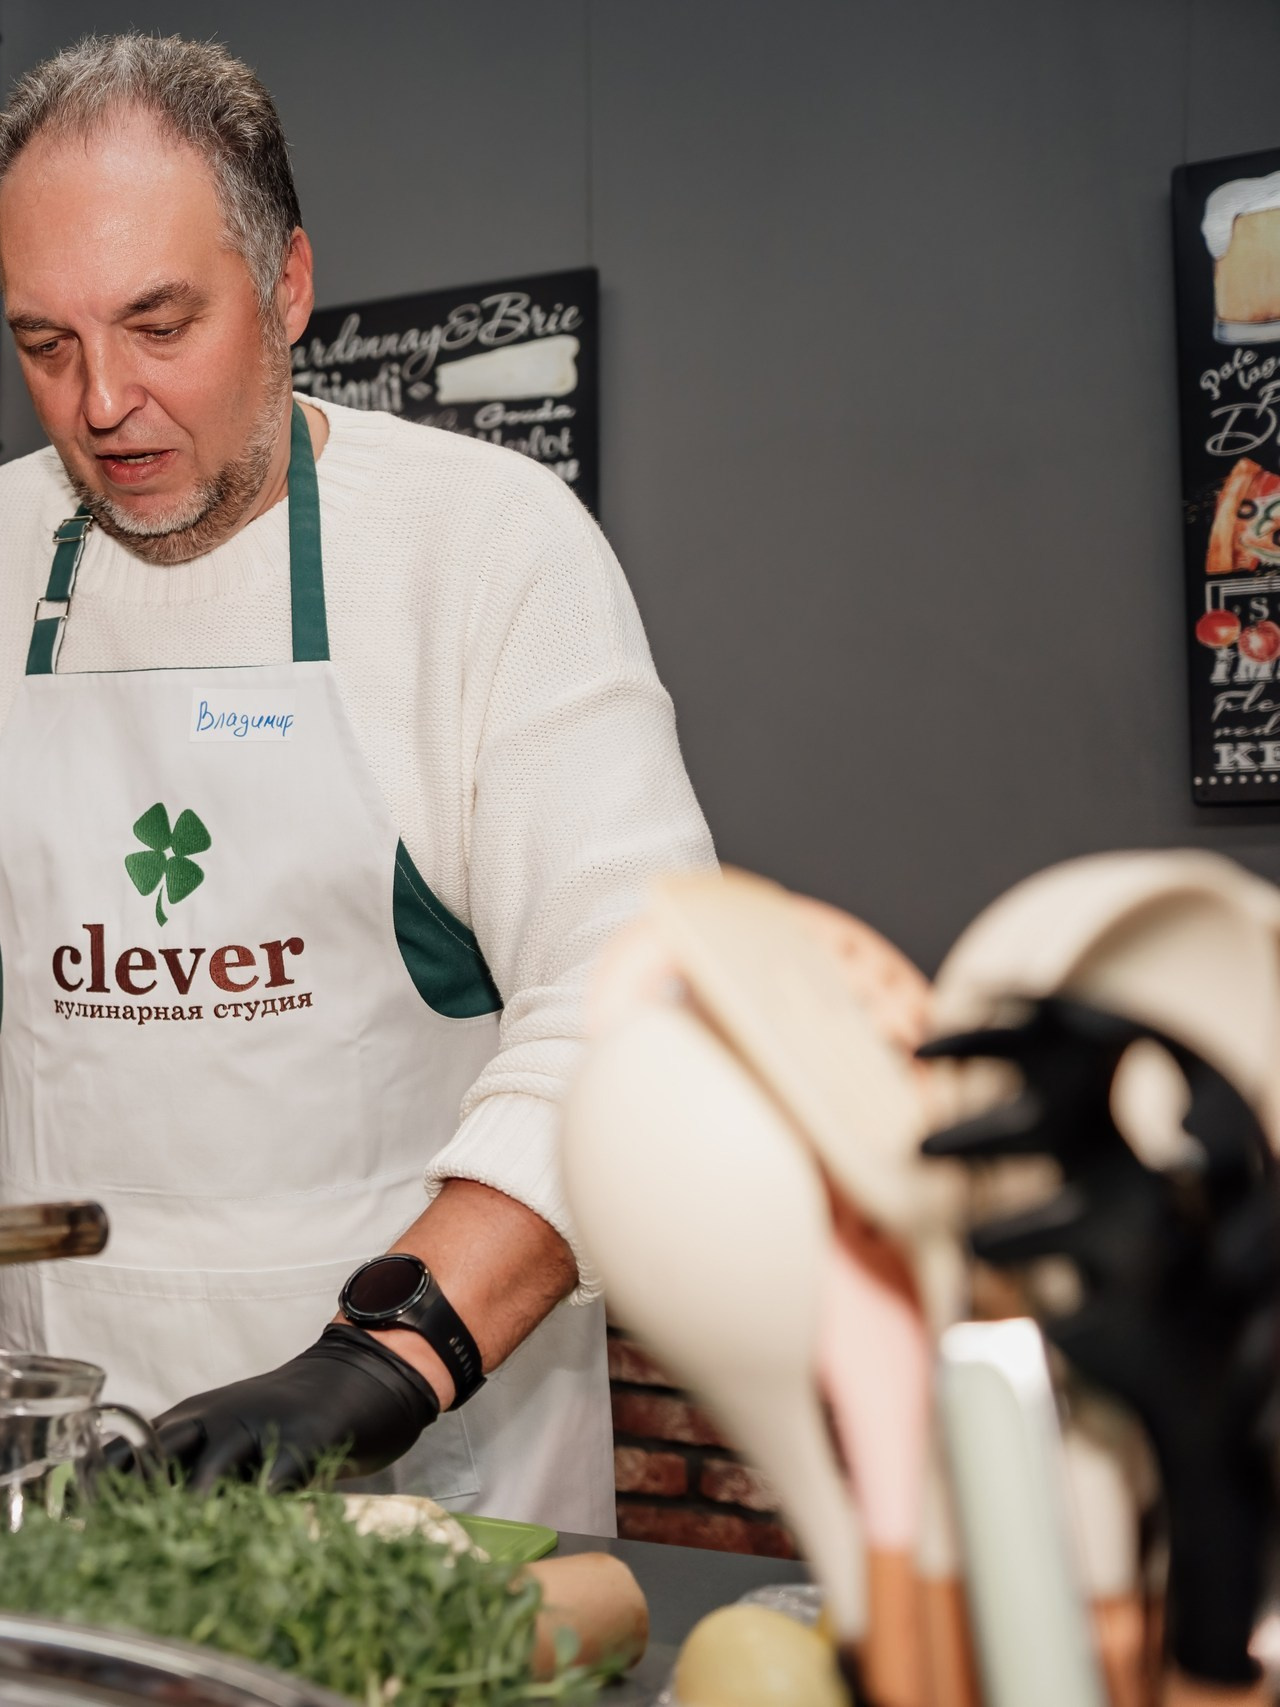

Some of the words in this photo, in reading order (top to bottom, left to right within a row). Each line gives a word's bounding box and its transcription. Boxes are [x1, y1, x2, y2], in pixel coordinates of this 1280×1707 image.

[1238, 356, 1280, 390] lag
[474, 399, 576, 430] Gouda
[196, 700, 294, 738] Владимир
[52, 923, 305, 996] clever
[54, 998, 204, 1025] кулинарная
[213, 992, 314, 1021] студия
